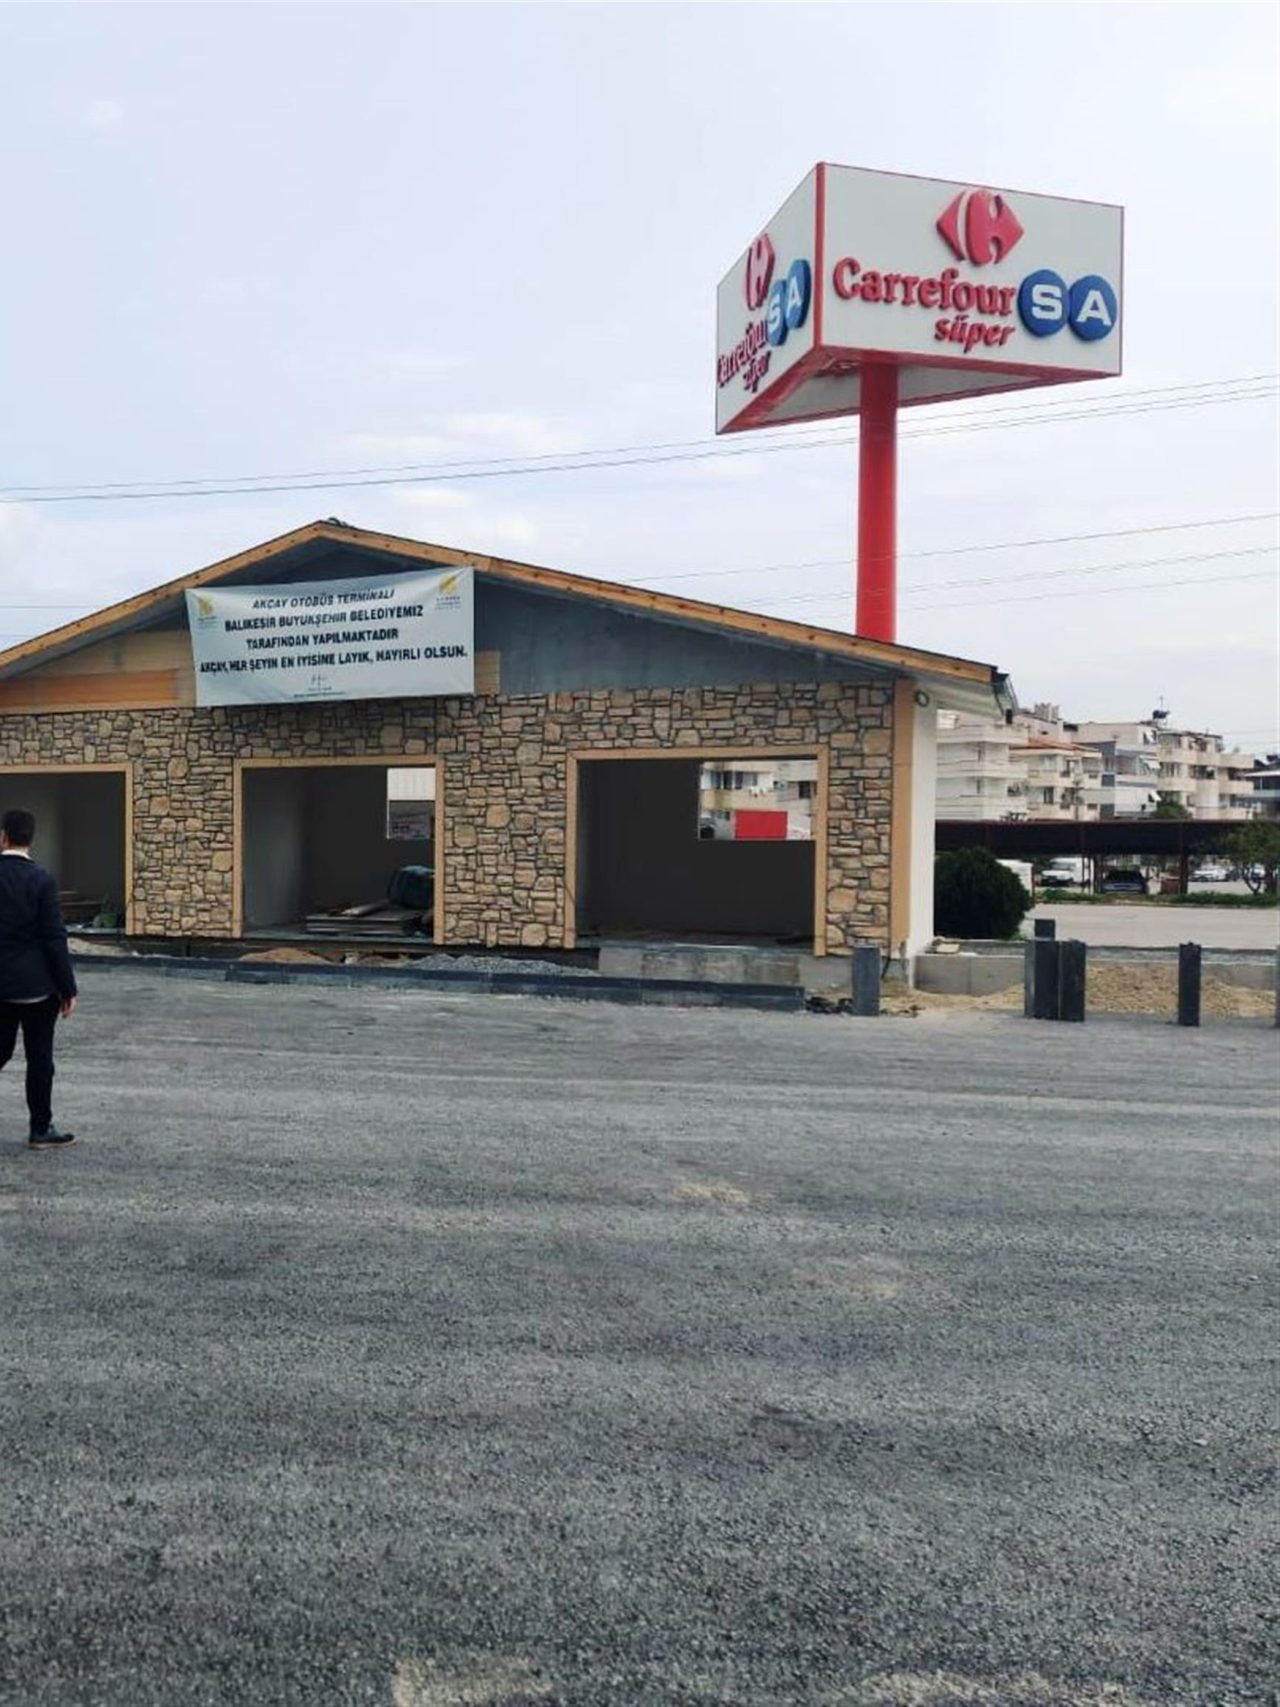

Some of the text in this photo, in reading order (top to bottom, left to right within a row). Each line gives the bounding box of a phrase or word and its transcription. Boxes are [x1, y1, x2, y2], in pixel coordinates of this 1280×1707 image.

[832, 256, 1017, 317] Carrefour
[933, 315, 1017, 355] süper
[246, 628, 399, 650] TARAFINDAN YAPILMAKTADIR
[281, 656, 295, 669] EN
[376, 647, 421, 662] HAYIRLI
